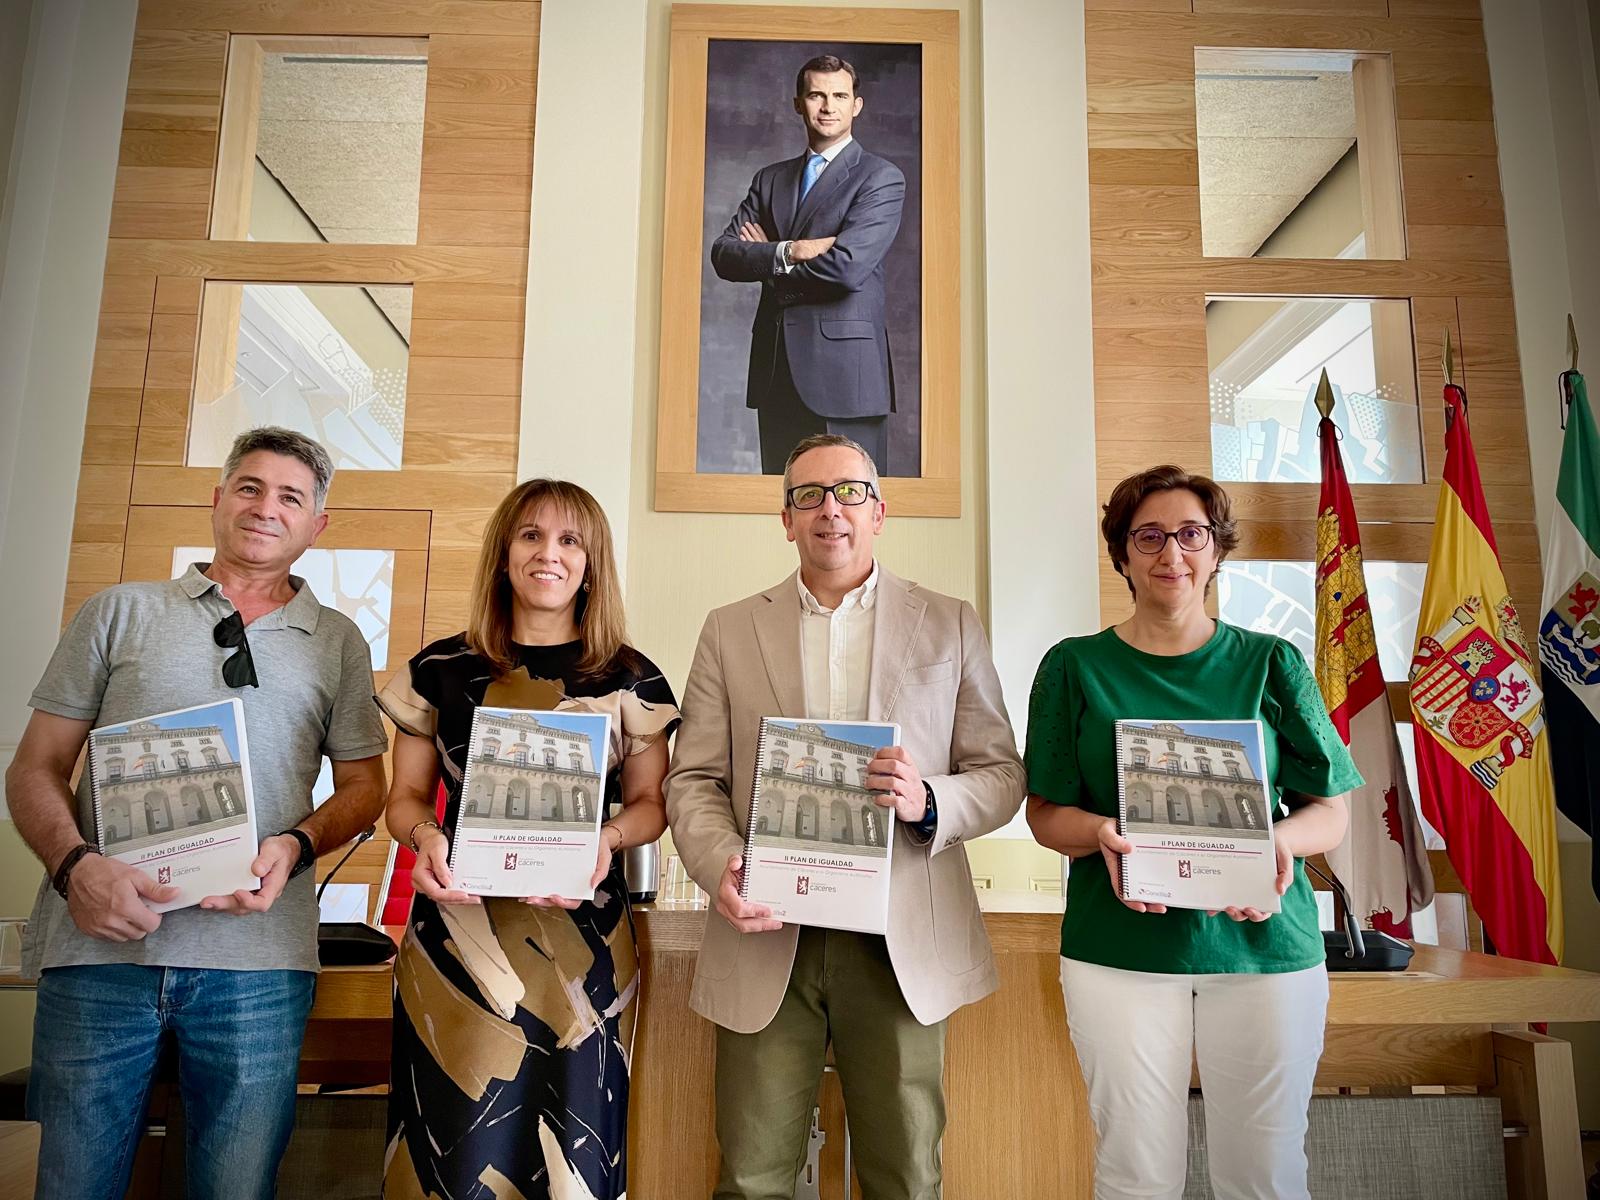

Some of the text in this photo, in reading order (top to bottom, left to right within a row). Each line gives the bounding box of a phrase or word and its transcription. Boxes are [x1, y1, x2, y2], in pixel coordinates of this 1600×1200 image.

[146, 849, 165, 858] PLAN
[166, 845, 176, 854] DE
[177, 837, 215, 852] IGUALDAD
[1167, 840, 1186, 848] PLAN
[1197, 842, 1235, 850] IGUALDAD
[789, 855, 807, 863] PLAN
[818, 858, 853, 868] IGUALDAD
